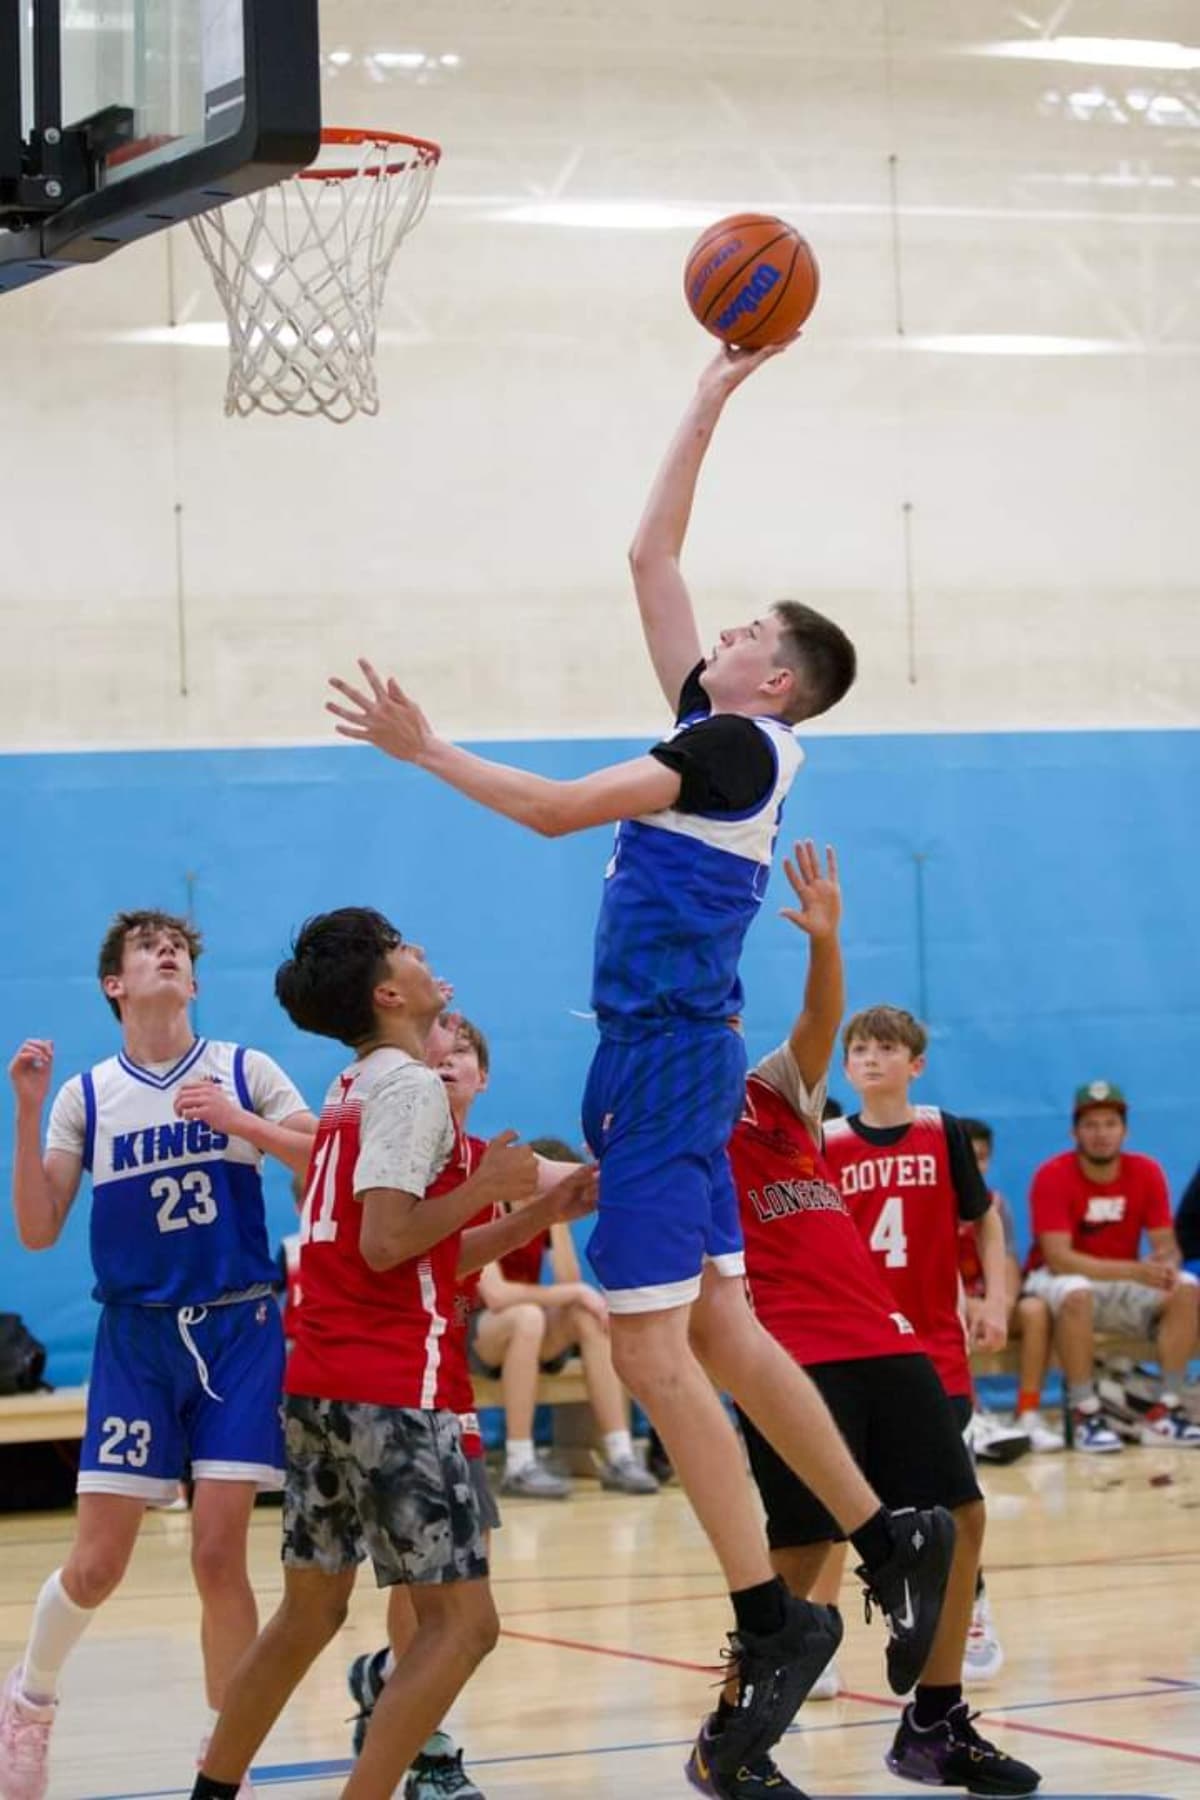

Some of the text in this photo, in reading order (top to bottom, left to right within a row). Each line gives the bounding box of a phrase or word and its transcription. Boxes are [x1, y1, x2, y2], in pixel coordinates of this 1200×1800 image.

[112, 1119, 229, 1172] KINGS
[841, 1155, 936, 1195] DOVER
[151, 1171, 218, 1233] 23
[870, 1197, 907, 1268] 4
[98, 1416, 151, 1467] 23
